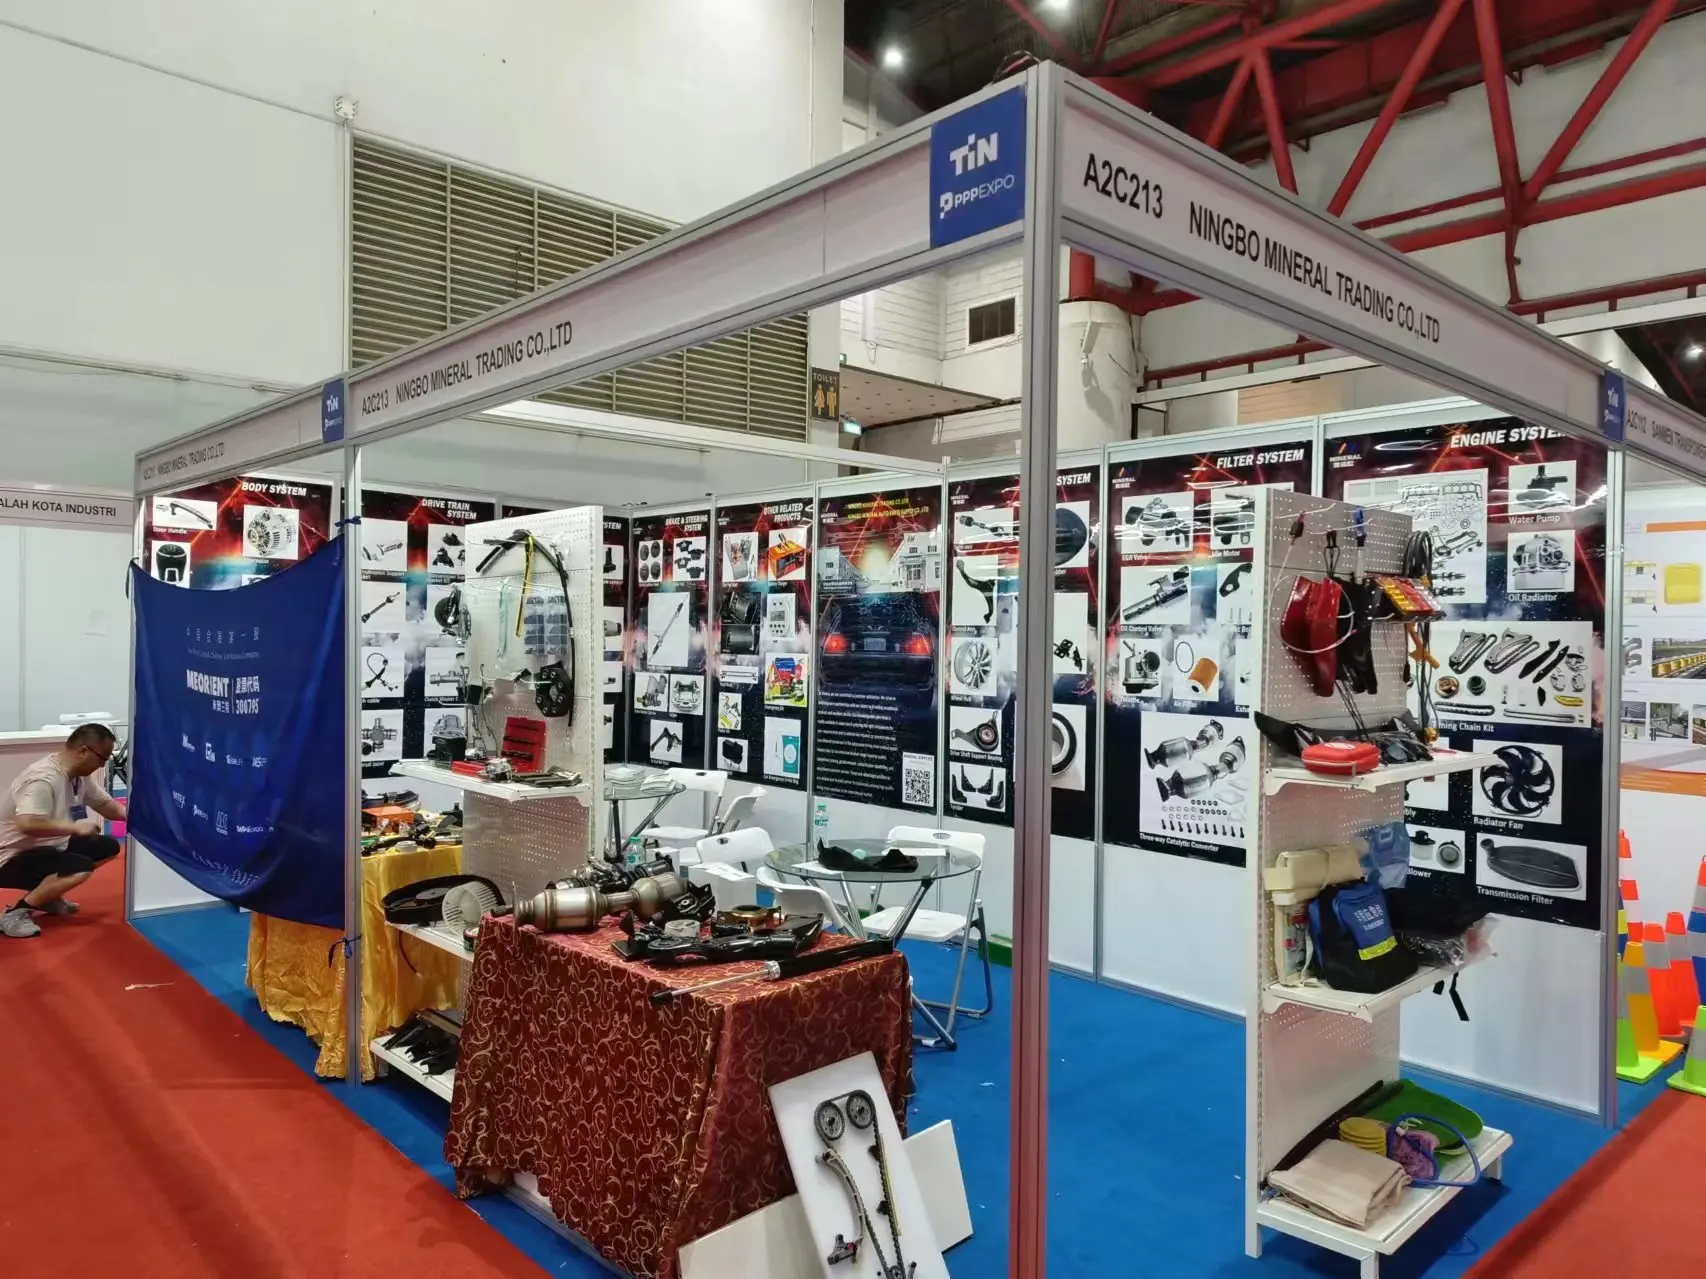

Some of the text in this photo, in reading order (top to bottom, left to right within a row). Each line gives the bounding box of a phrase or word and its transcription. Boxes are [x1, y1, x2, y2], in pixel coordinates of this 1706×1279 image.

[1083, 152, 1163, 219] A2C213
[1189, 201, 1260, 262] NINGBO
[1264, 237, 1332, 296] MINERAL
[1336, 271, 1393, 322] TRADING
[362, 388, 389, 416] A2C213
[396, 374, 429, 404] NINGBO
[431, 360, 472, 393] MINERAL
[476, 340, 523, 376] TRADING
[813, 373, 837, 384] TOILET
[1450, 426, 1566, 448] ENGINE SYSTE
[1217, 449, 1304, 469] FILTER SYSTEM
[1329, 454, 1362, 463] MINERAL
[1056, 473, 1091, 486] SYSTEM
[242, 481, 307, 497] BODY SYSTEM
[32, 500, 63, 513] KOTA
[65, 503, 116, 517] INDUSTRI
[421, 498, 470, 510] DRIVE TRAIN
[780, 503, 803, 513] RELATED
[447, 510, 477, 520] SYSTEM
[685, 514, 708, 523] STEERING
[774, 512, 802, 523] PRODUCTS
[1508, 513, 1560, 525] Water Pump
[168, 527, 187, 535] Handle
[1223, 549, 1240, 557] Motor
[1508, 592, 1557, 603] Oil Radiator
[186, 668, 230, 698] MEORIENT
[235, 699, 260, 715] 300795
[1235, 705, 1250, 713] Exha
[1459, 721, 1481, 731] Chain
[1482, 722, 1495, 732] Kit
[1473, 817, 1524, 830] Radiator Fan
[1139, 832, 1219, 852] Three-way Catalytic Converter
[1476, 886, 1554, 905] Transmission Filter
